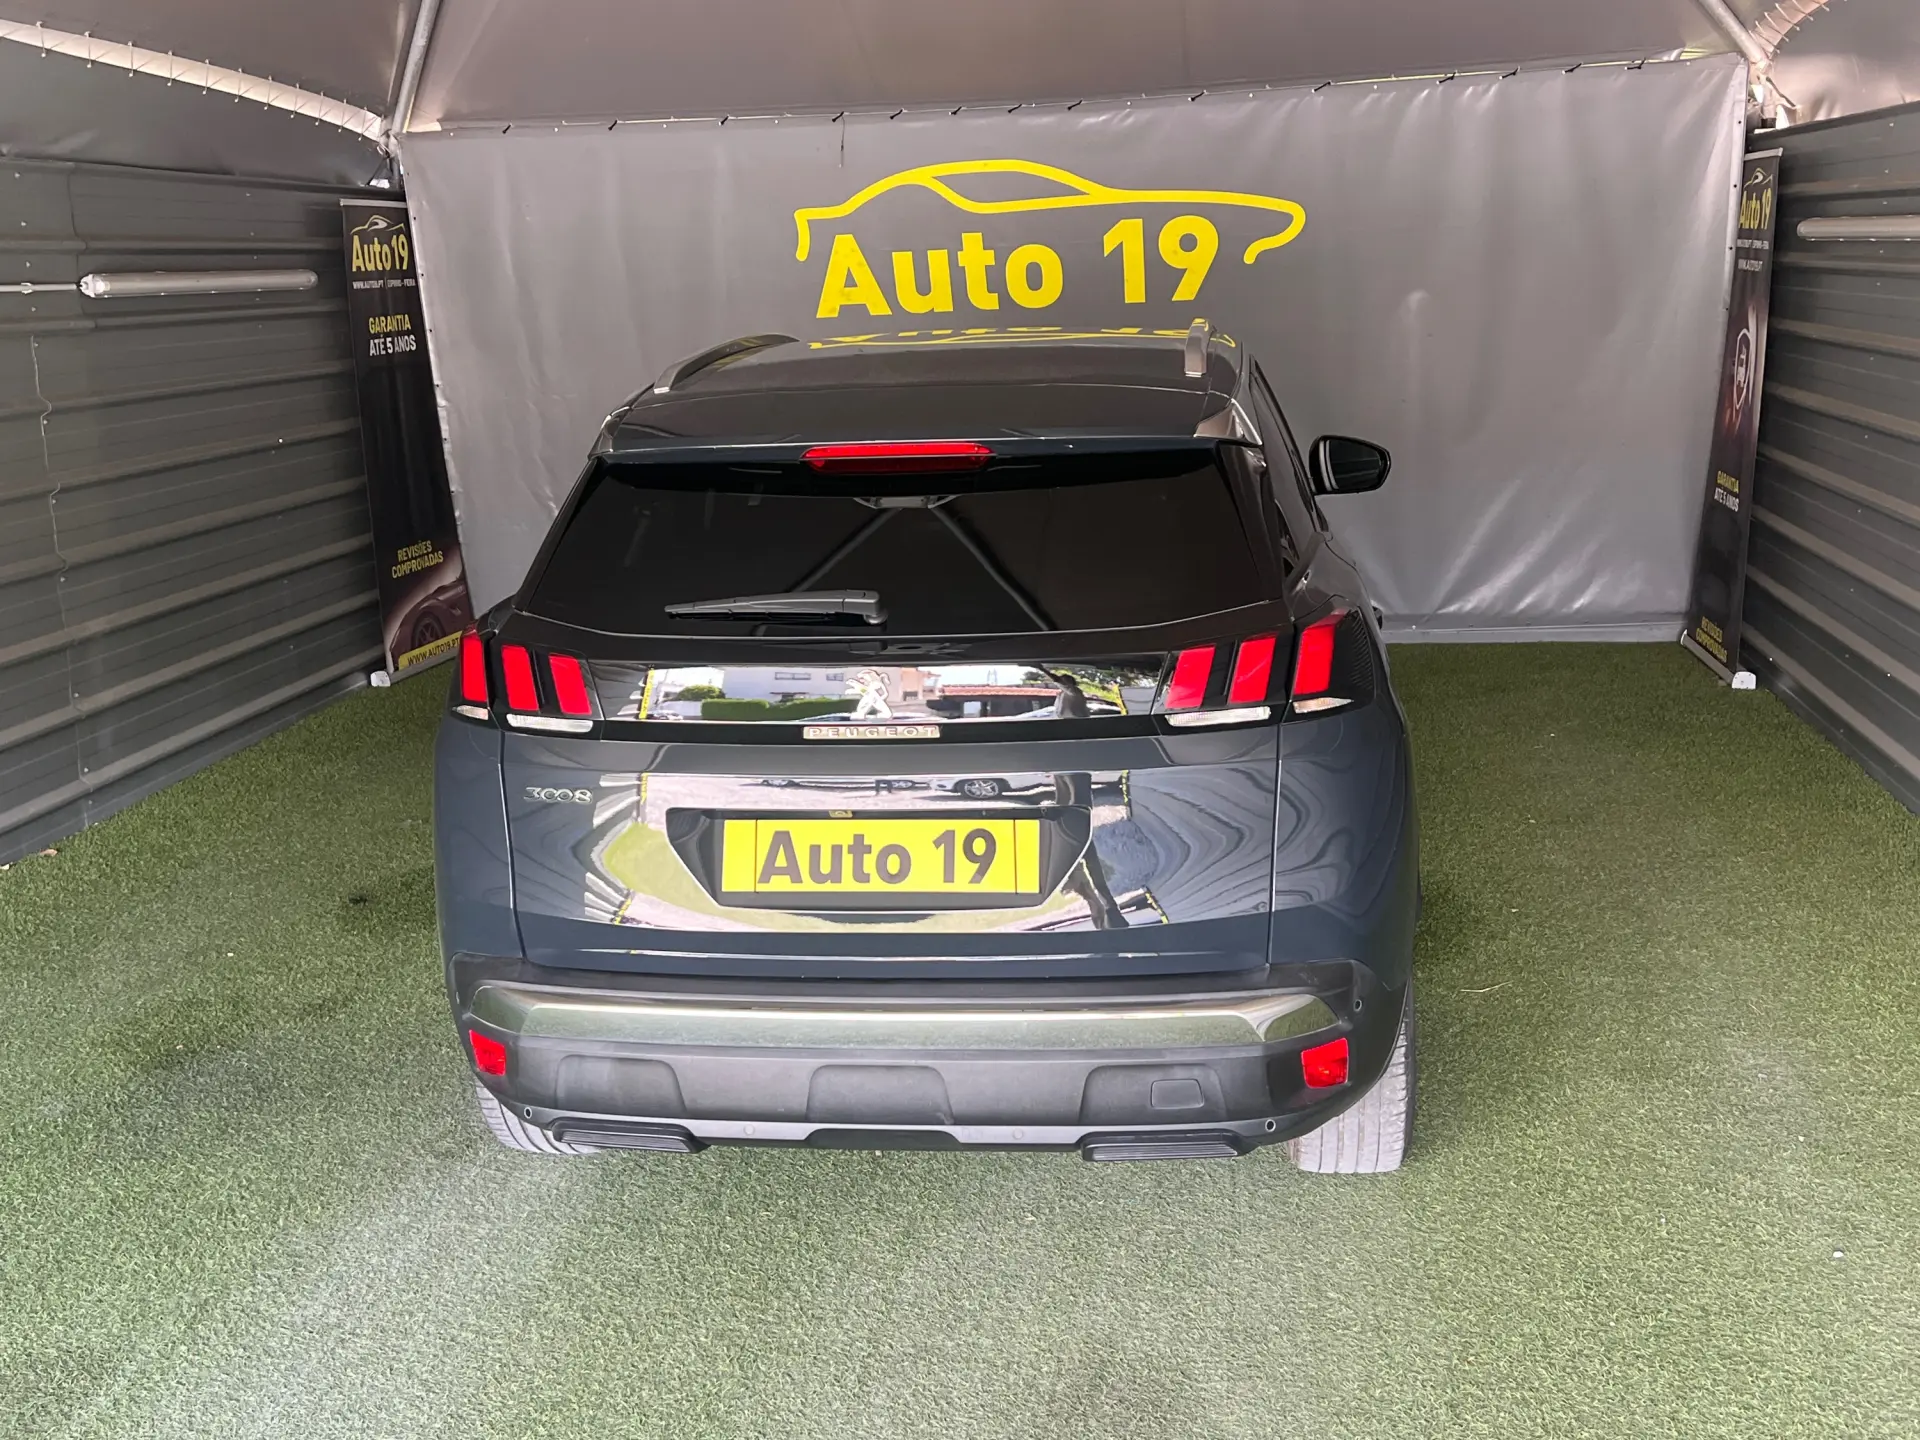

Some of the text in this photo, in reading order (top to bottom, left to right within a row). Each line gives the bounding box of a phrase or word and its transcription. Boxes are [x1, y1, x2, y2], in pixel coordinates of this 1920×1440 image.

[352, 234, 409, 272] Auto 19
[816, 214, 1219, 318] Auto 19
[369, 313, 412, 334] GARANTIA
[369, 333, 417, 356] ATÉ 5 ANOS
[391, 550, 444, 579] COMPROVADAS
[407, 636, 460, 667] WWW.AUTO19.PT
[807, 726, 937, 738] PEUGEOT
[523, 786, 593, 804] 3008
[757, 827, 997, 884] Auto 19
